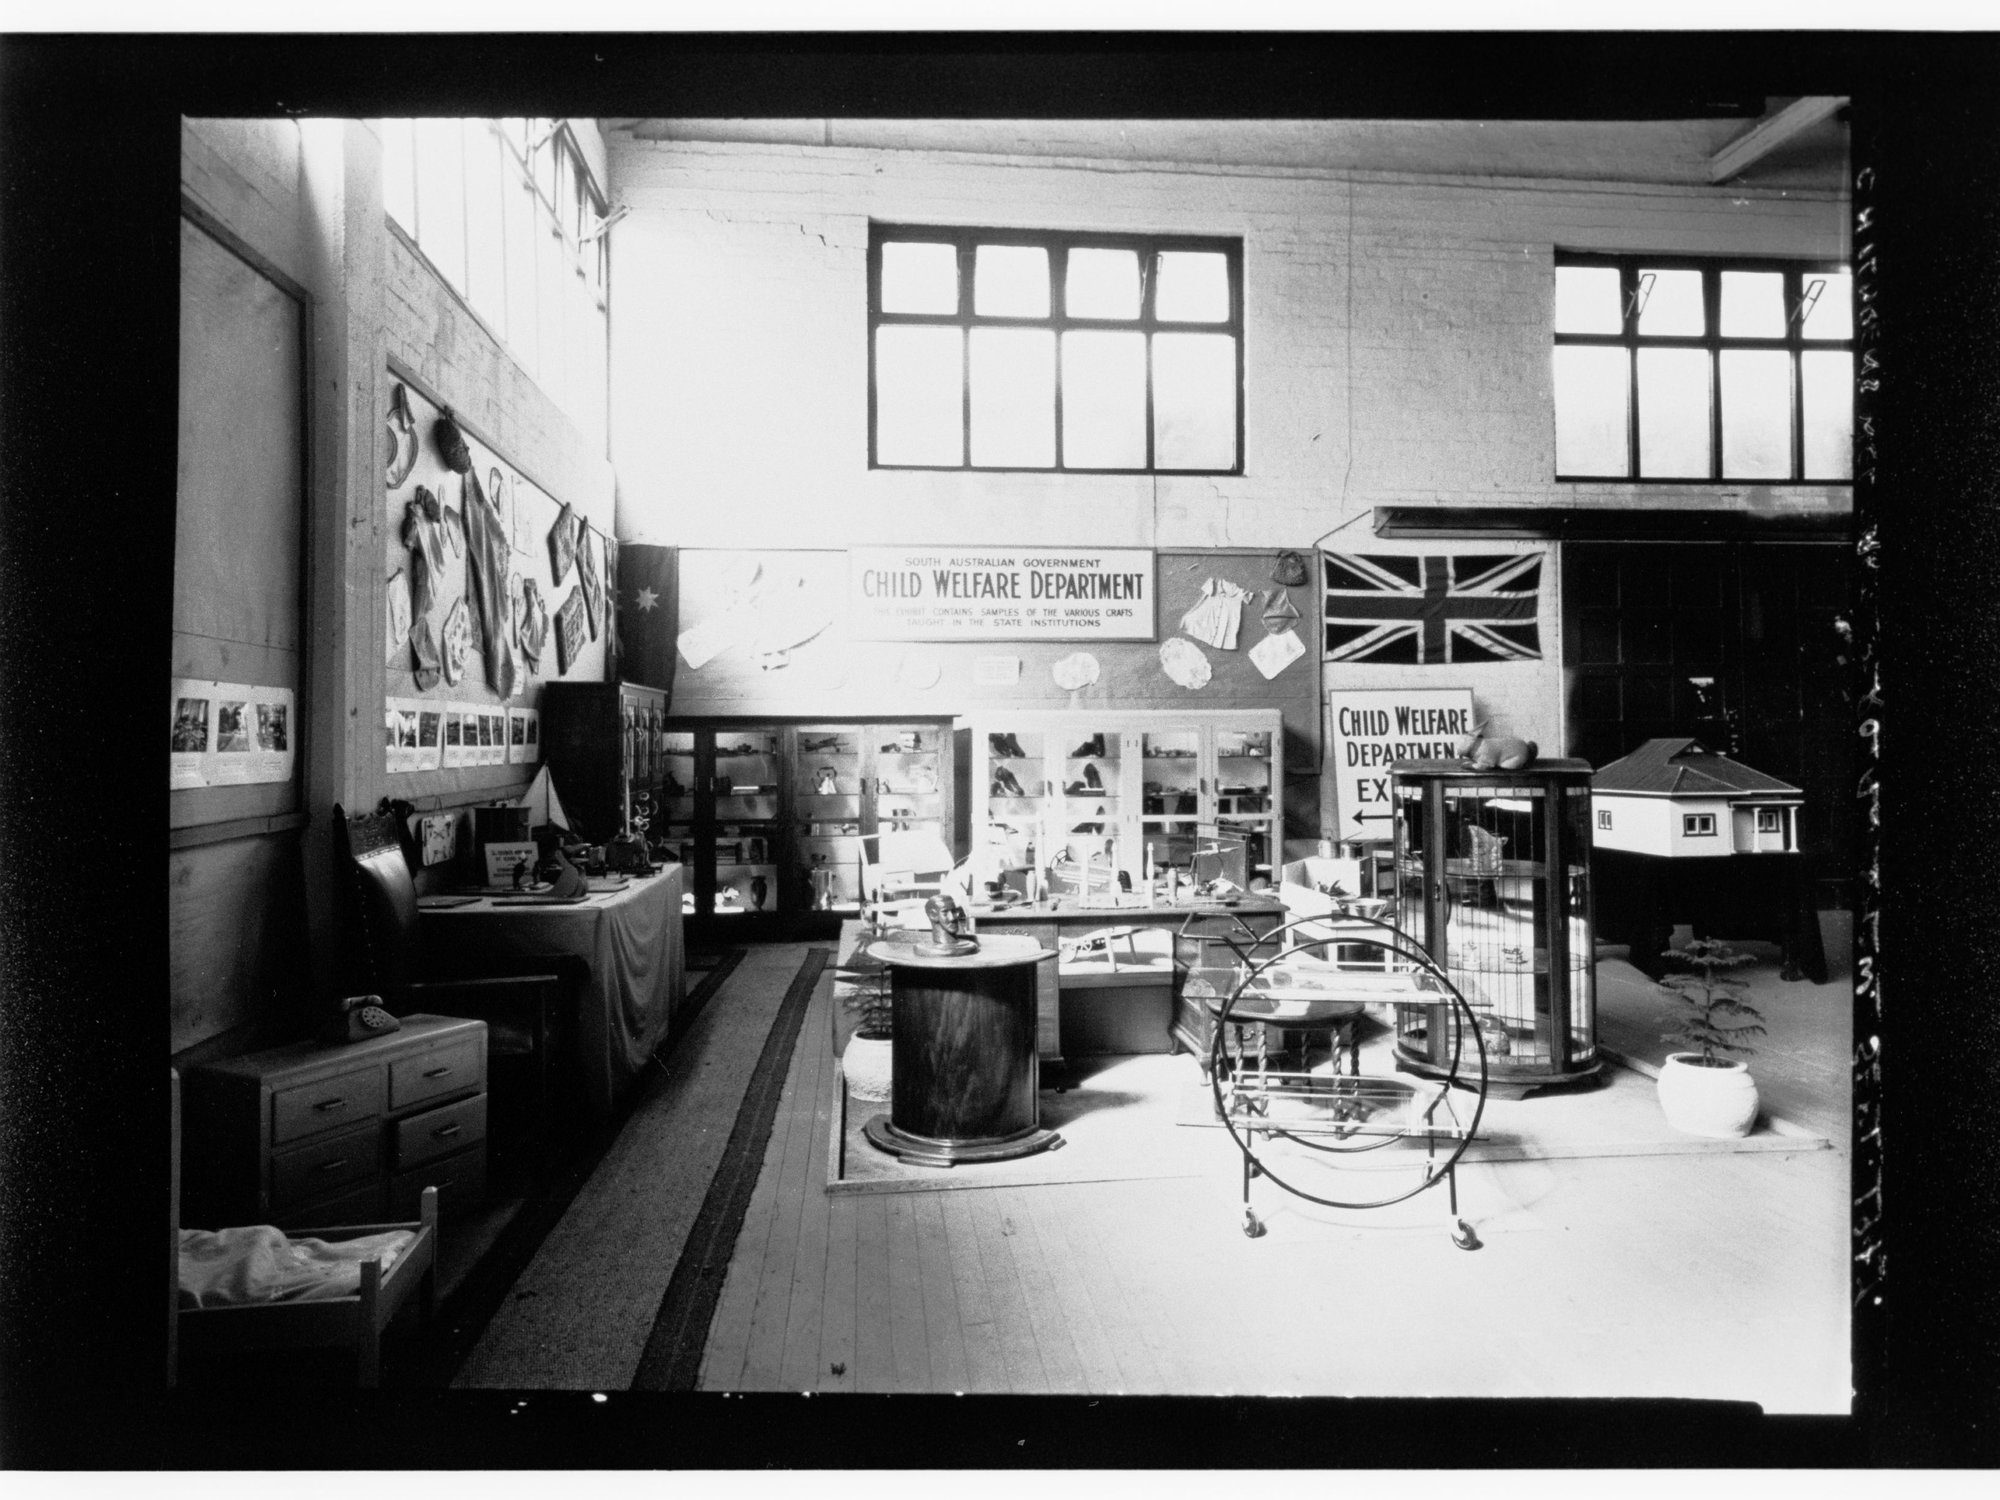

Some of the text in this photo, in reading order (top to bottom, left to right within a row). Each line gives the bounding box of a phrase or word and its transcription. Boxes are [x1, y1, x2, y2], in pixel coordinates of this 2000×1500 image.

[904, 556, 1102, 569] SOUTH AUSTRALIAN GOVERNMENT
[862, 568, 1144, 601] CHILD WELFARE DEPARTMENT
[906, 617, 1102, 627] TAUGHT IN THE STATE INSTITUTIONS
[932, 606, 973, 617] CONTAINS
[980, 607, 1020, 618] SAMPLES
[1026, 607, 1037, 618] OF
[1042, 607, 1058, 618] THE
[1064, 608, 1101, 618] VARIOUS
[1105, 608, 1134, 618] CRAFTS
[1338, 705, 1469, 737] CHILD WELFARE
[1346, 740, 1456, 768] DEPARTMEN
[1356, 778, 1390, 803] EX
